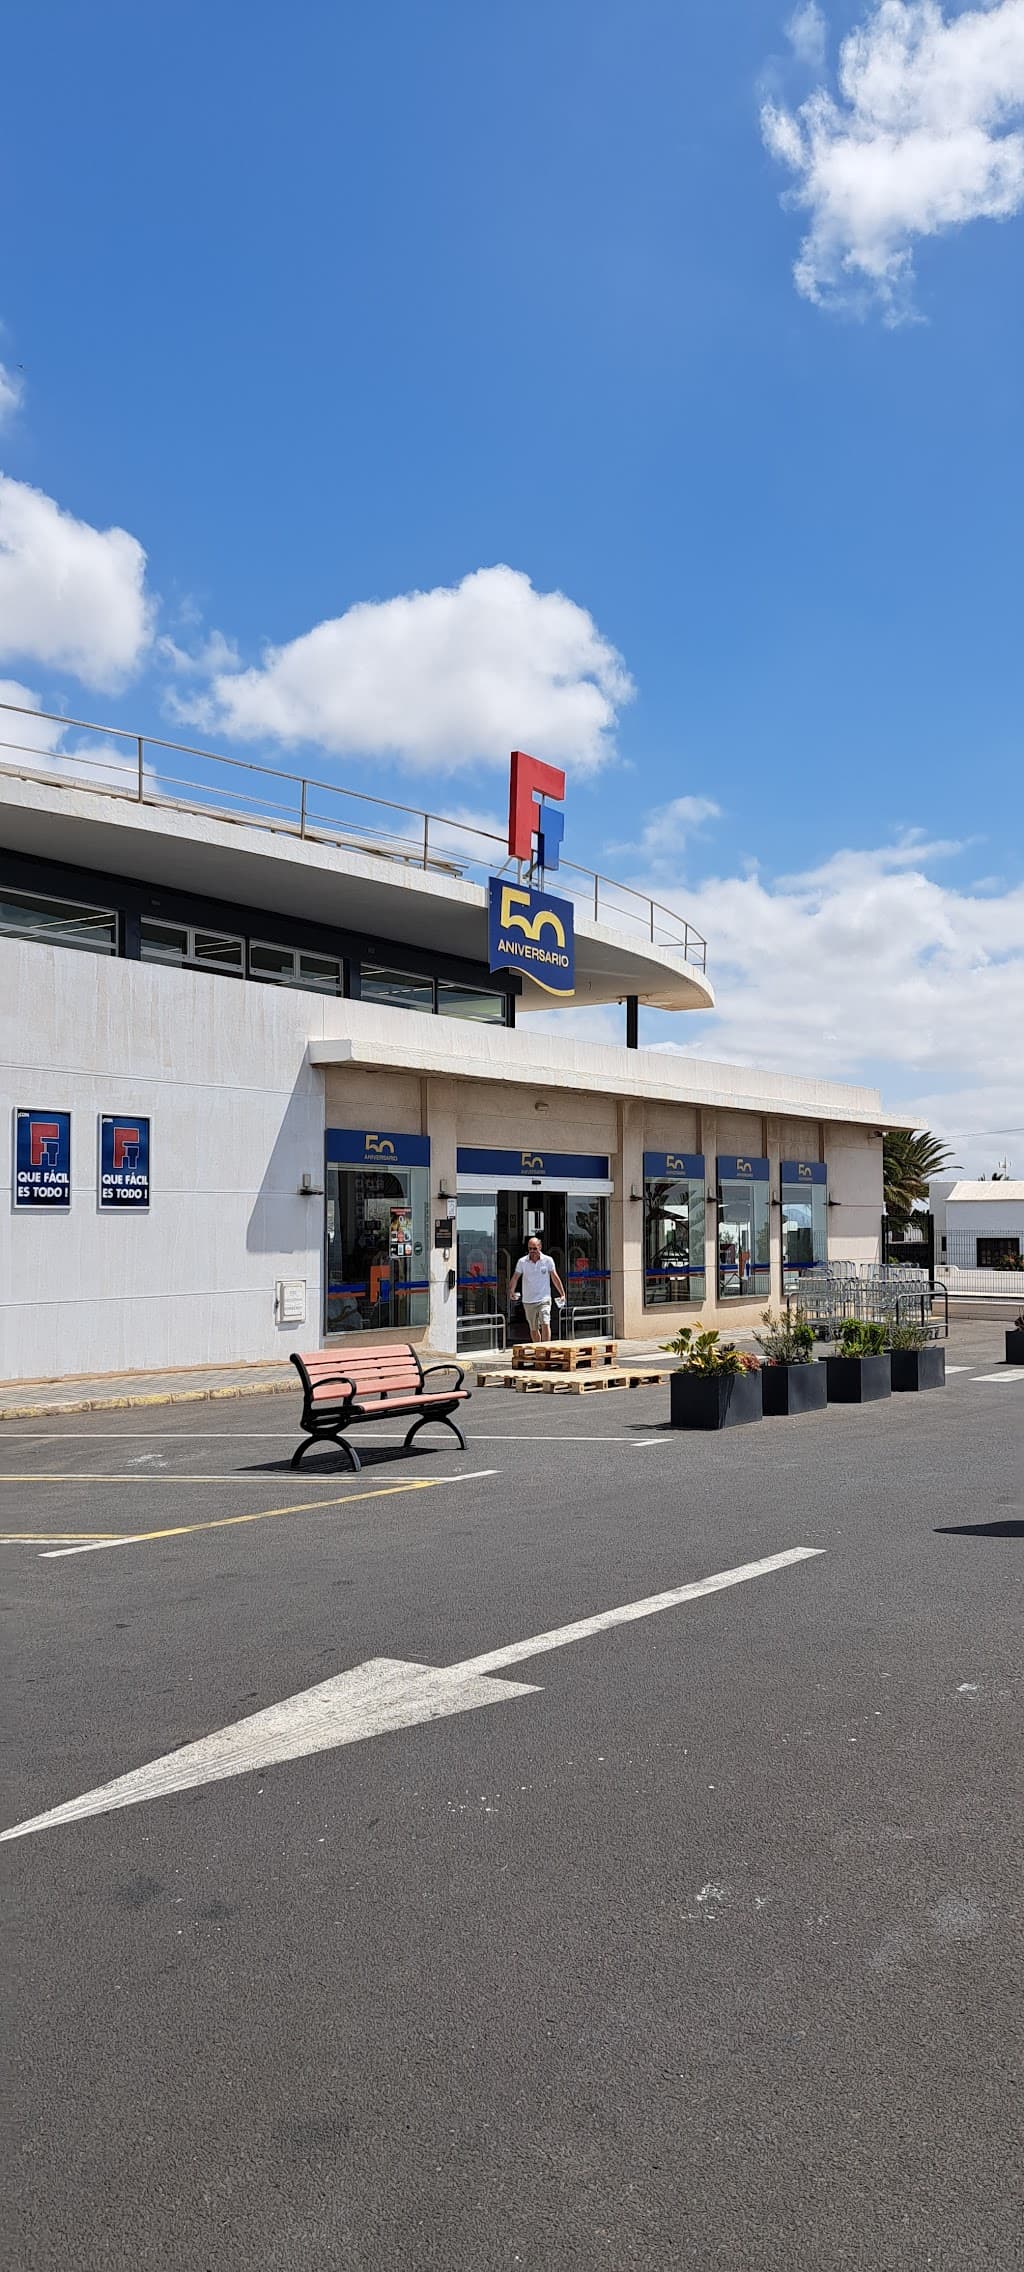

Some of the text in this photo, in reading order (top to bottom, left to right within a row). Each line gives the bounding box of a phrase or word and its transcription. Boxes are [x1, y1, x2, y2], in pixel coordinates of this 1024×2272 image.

[501, 886, 566, 948] 50
[498, 938, 569, 968] ANIVERSARIO
[365, 1134, 395, 1154] 50
[18, 1169, 69, 1183] QUE FÁCIL
[102, 1172, 149, 1186] QUE FÁCIL
[18, 1186, 30, 1197] ES
[33, 1186, 62, 1198] TODO
[102, 1188, 113, 1199] ES
[116, 1188, 142, 1199] TODO
